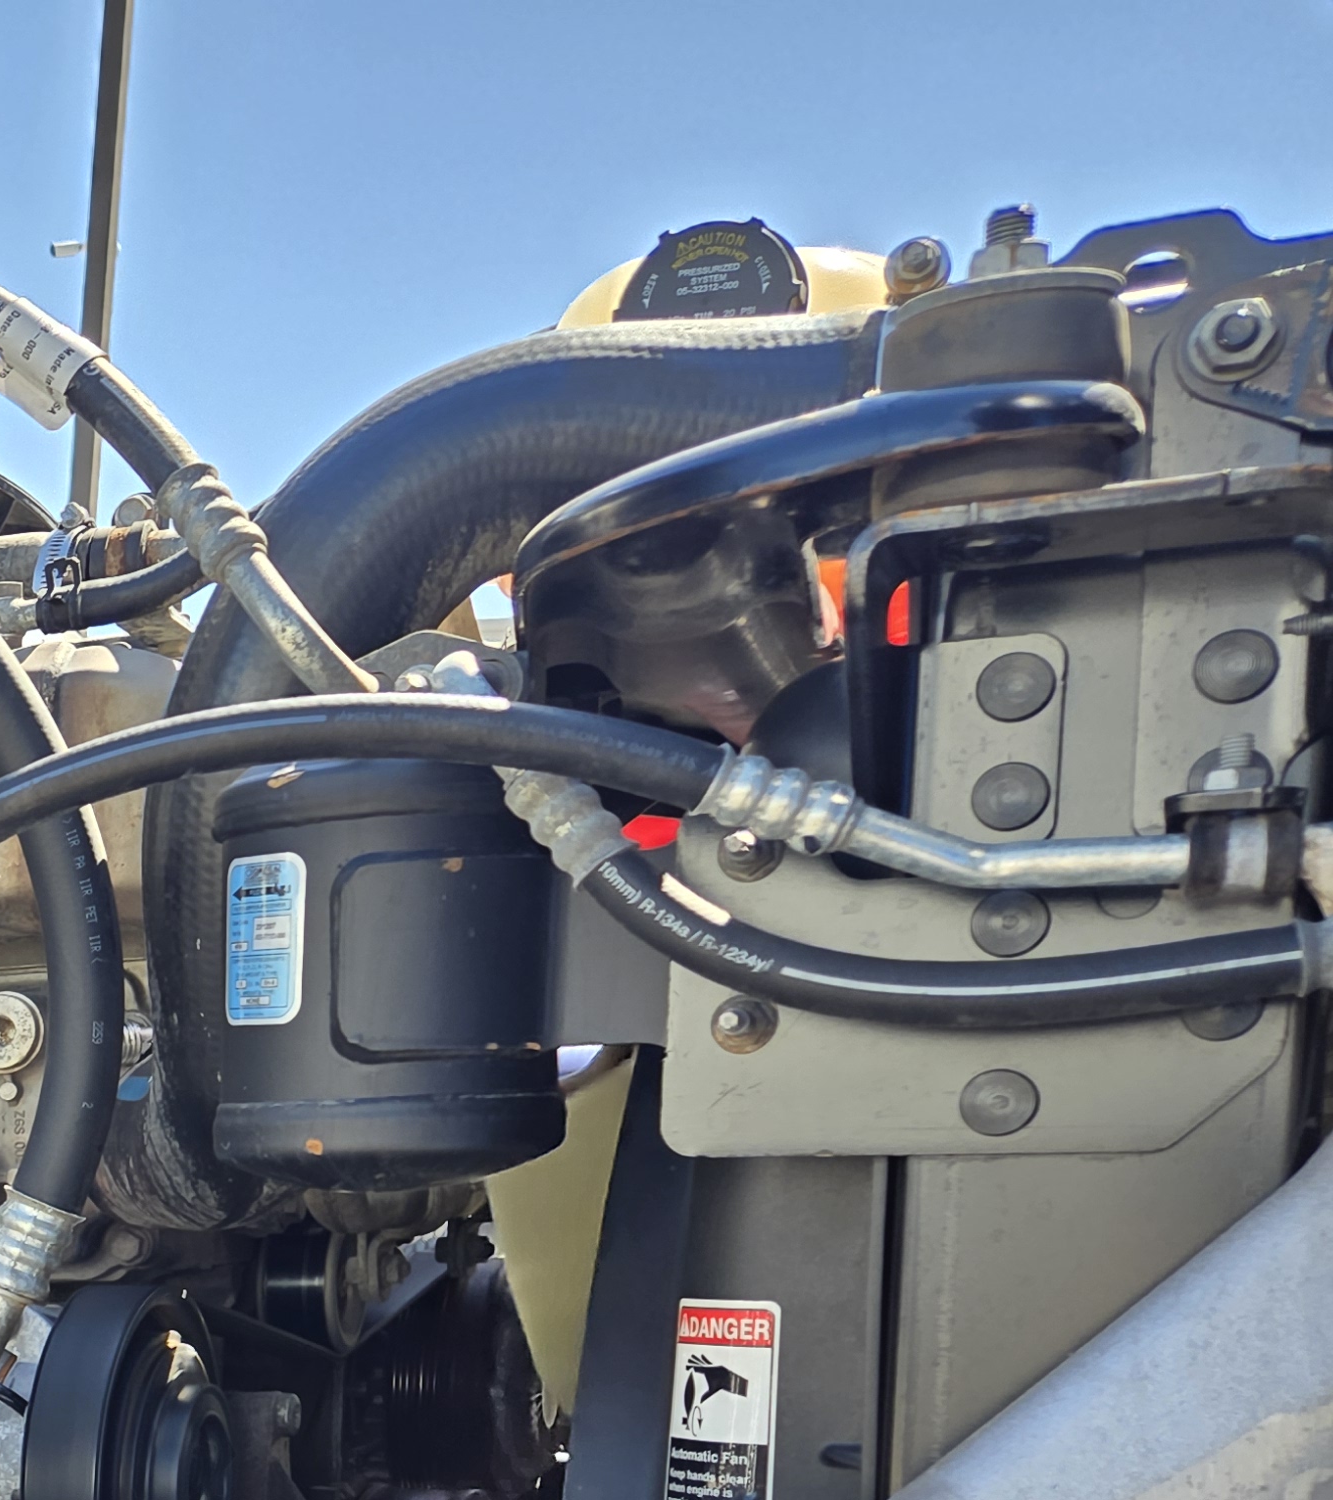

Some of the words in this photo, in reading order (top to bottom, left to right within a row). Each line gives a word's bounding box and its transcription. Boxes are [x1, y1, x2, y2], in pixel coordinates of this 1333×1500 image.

[688, 231, 747, 249] CAUTION
[678, 262, 741, 277] PRESSURIZED
[690, 273, 727, 285] SYSTEM
[50, 347, 76, 374] Made
[85, 906, 98, 923] PET
[637, 897, 691, 941] R-134a
[689, 1317, 770, 1341] DANGER
[671, 1447, 719, 1463] Automatic
[722, 1451, 748, 1466] Fan
[687, 1470, 716, 1483] hands
[718, 1473, 750, 1485] clear
[686, 1487, 720, 1498] engine
[723, 1489, 733, 1498] is
